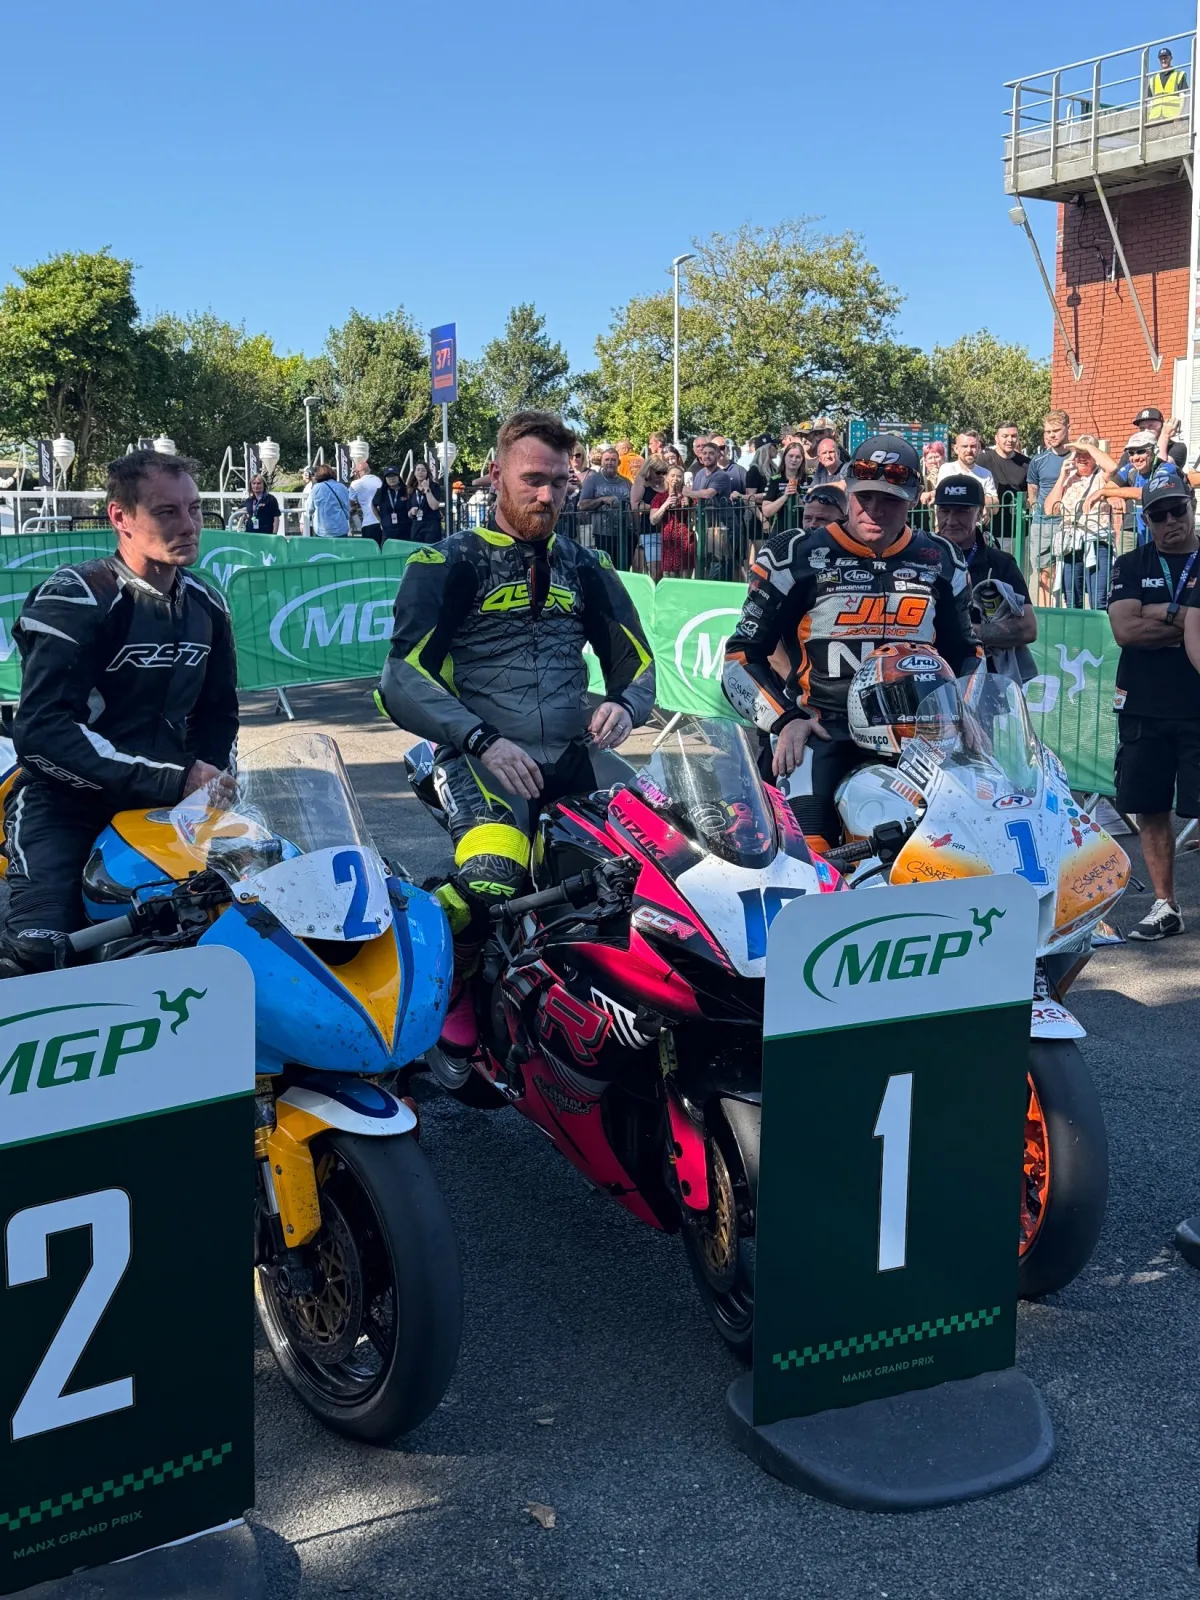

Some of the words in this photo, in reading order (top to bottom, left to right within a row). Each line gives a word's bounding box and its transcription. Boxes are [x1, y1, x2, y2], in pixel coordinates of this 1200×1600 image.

[834, 596, 930, 627] JLG
[106, 641, 211, 672] RST
[901, 655, 936, 669] Arai
[1005, 820, 1048, 885] 1
[332, 850, 381, 941] 2
[832, 930, 972, 988] MGP
[872, 1071, 914, 1273] 1
[5, 1187, 135, 1442] 2
[842, 1369, 873, 1384] MANX
[874, 1360, 910, 1377] GRAND
[911, 1355, 935, 1368] PRIX
[13, 1538, 56, 1560] MANX
[58, 1522, 108, 1545] GRAND
[111, 1510, 143, 1528] PRIX
